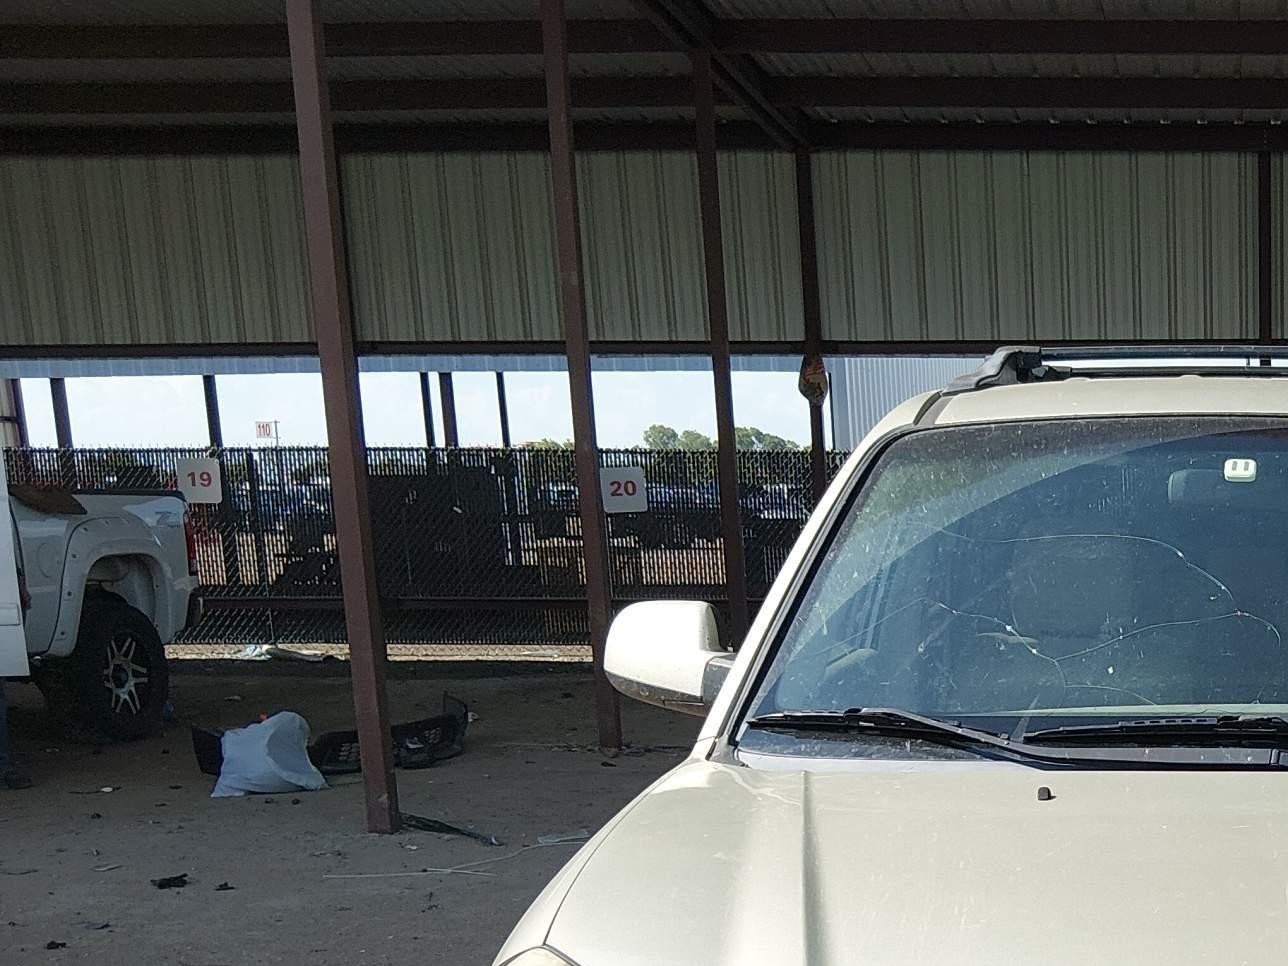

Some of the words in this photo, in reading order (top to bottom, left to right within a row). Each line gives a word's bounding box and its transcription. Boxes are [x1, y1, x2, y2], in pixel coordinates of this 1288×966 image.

[257, 423, 271, 437] 110
[187, 471, 212, 487] 19
[610, 480, 637, 497] 20
